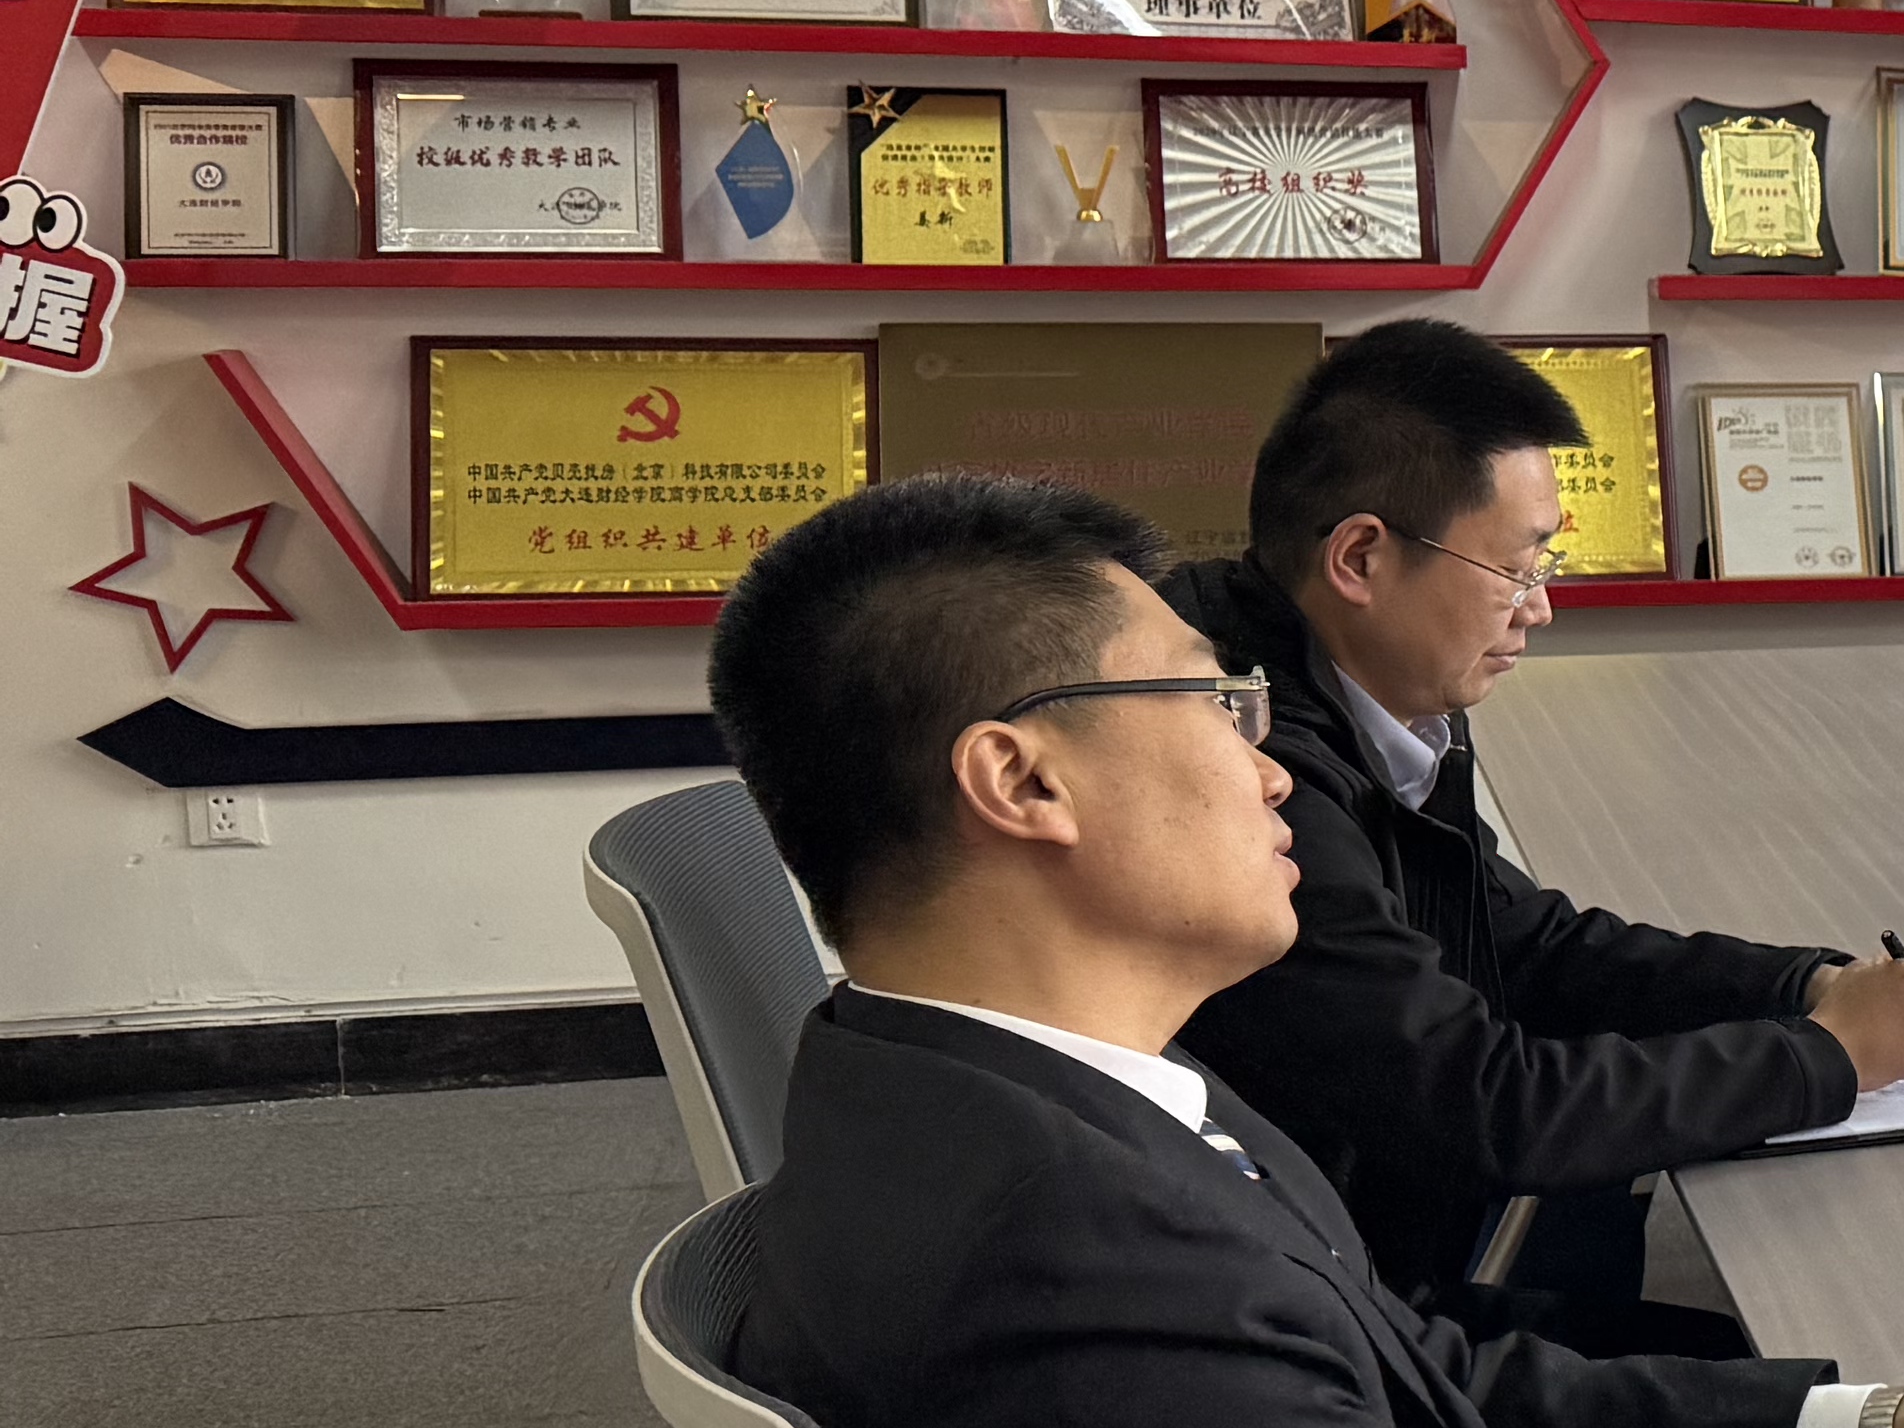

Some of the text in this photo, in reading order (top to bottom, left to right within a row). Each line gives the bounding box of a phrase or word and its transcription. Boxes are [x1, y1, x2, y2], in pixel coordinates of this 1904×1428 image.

[416, 145, 621, 169] 校级优秀教学团队
[527, 523, 773, 555] 党组织共建单位
